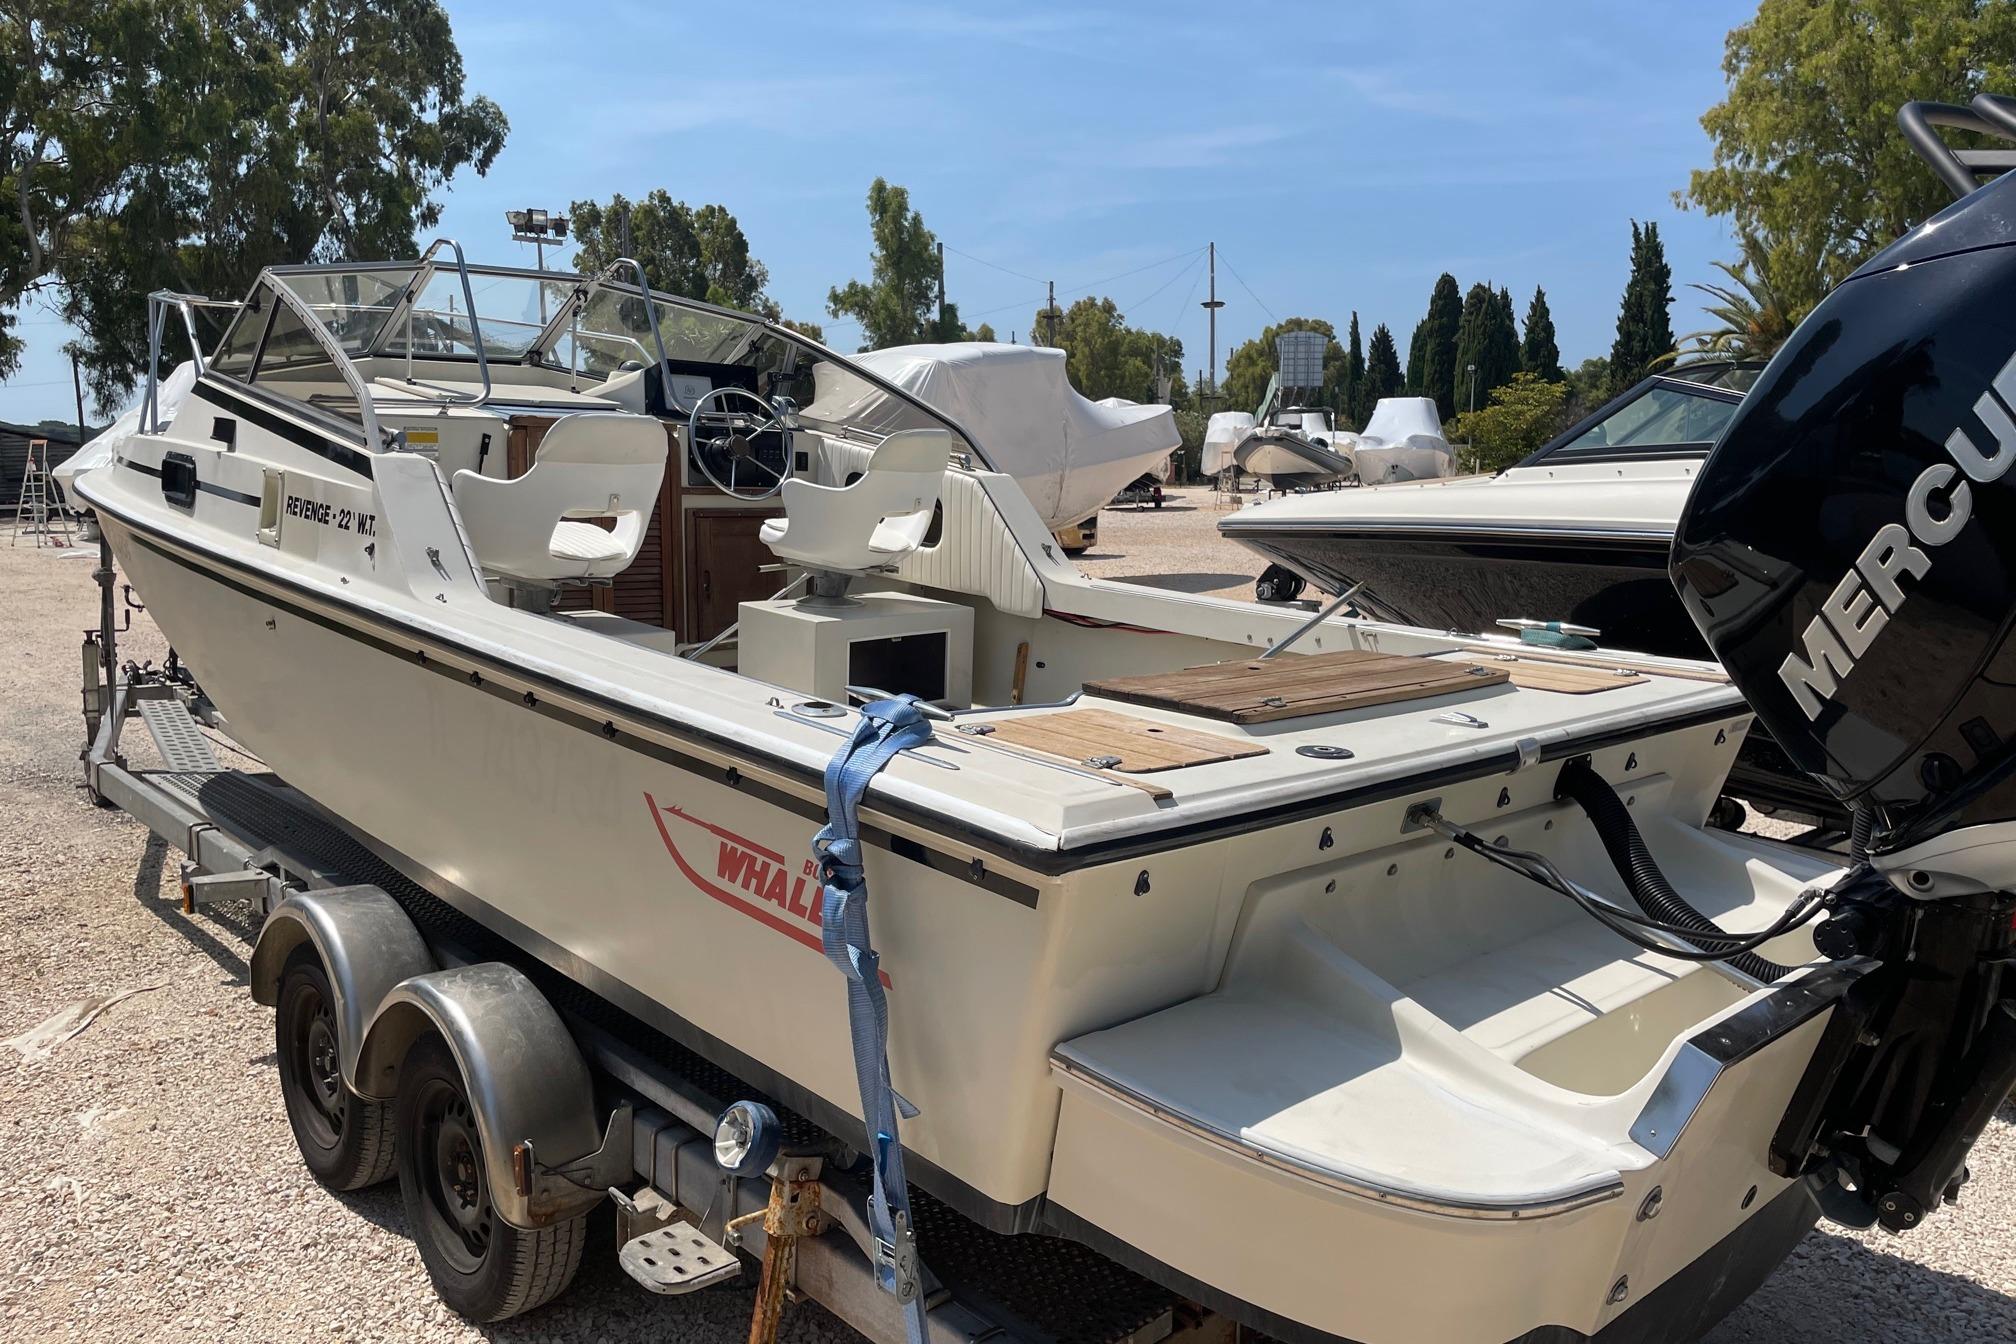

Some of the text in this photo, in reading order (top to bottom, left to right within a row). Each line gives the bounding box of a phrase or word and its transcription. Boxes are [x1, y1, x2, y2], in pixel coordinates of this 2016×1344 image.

[286, 495, 331, 525] REVENGE
[357, 512, 376, 537] W.T.
[717, 841, 823, 928] WHAL
